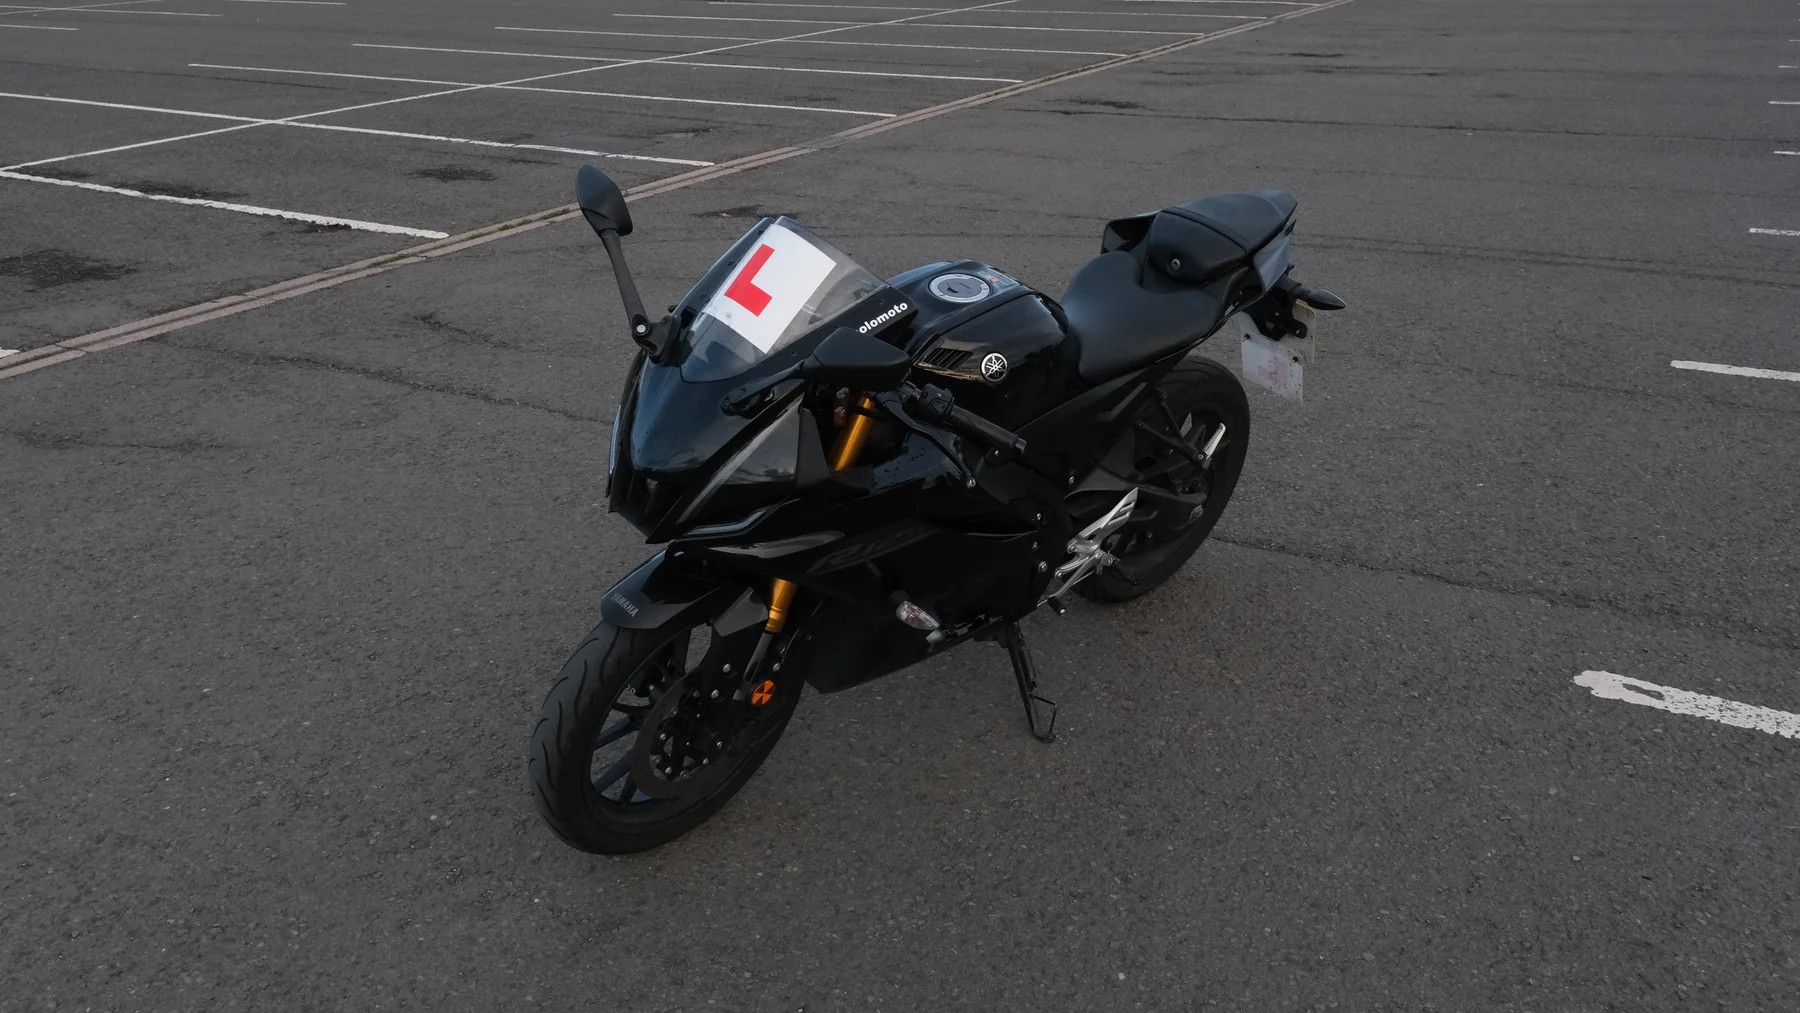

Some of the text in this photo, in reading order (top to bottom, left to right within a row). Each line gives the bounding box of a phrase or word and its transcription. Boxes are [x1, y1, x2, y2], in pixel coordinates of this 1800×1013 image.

[724, 244, 775, 317] L
[857, 302, 908, 334] olomoto
[611, 593, 639, 617] YAMAHA
